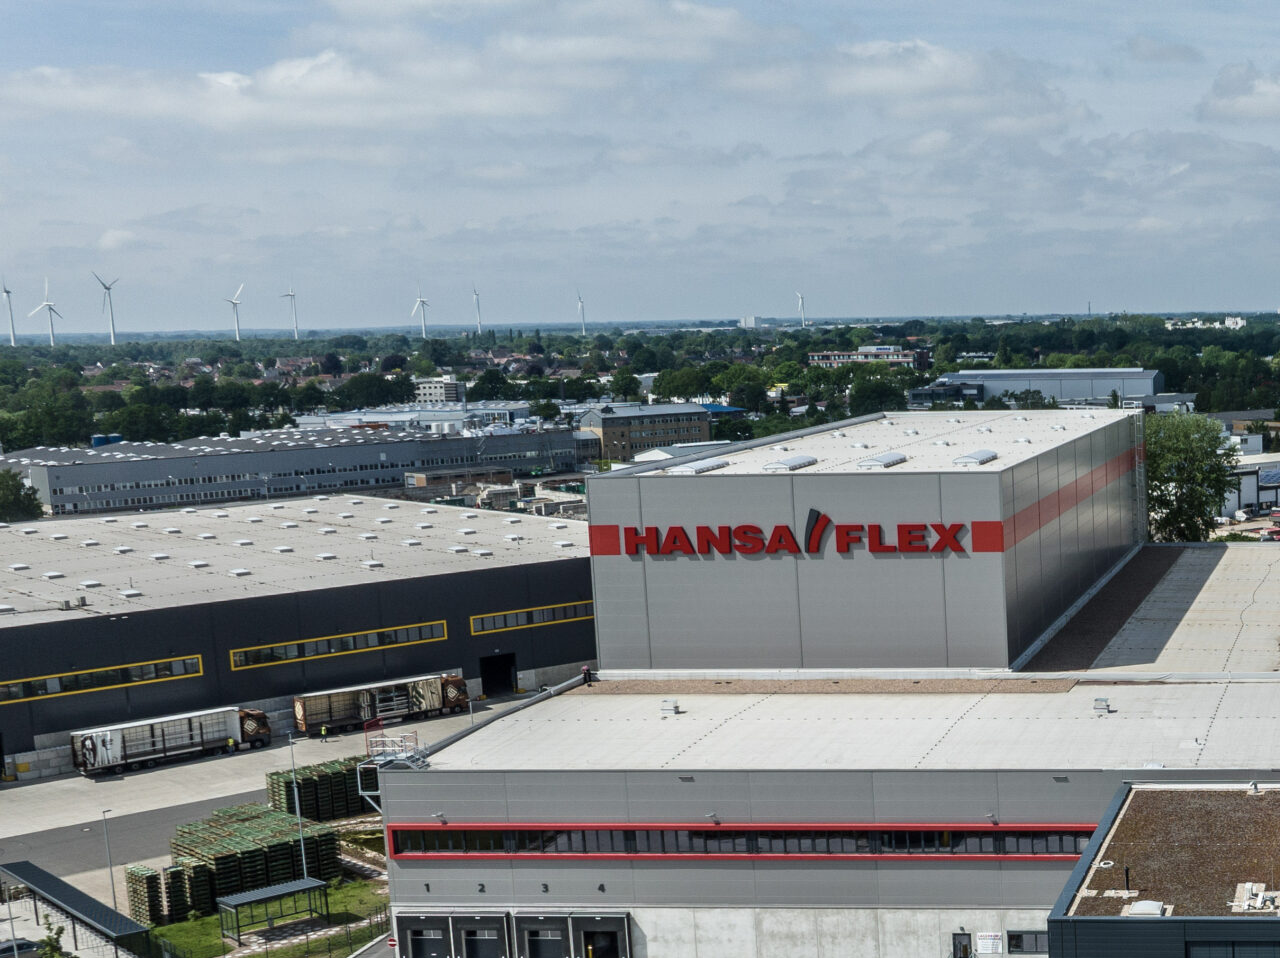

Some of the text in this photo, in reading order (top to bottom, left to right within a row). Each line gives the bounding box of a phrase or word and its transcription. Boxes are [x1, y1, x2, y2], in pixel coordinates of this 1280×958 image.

[624, 523, 966, 555] HANSA FLEX
[424, 883, 431, 893] 1
[477, 883, 486, 893] 2
[541, 883, 549, 894] 3
[597, 883, 606, 893] 4
